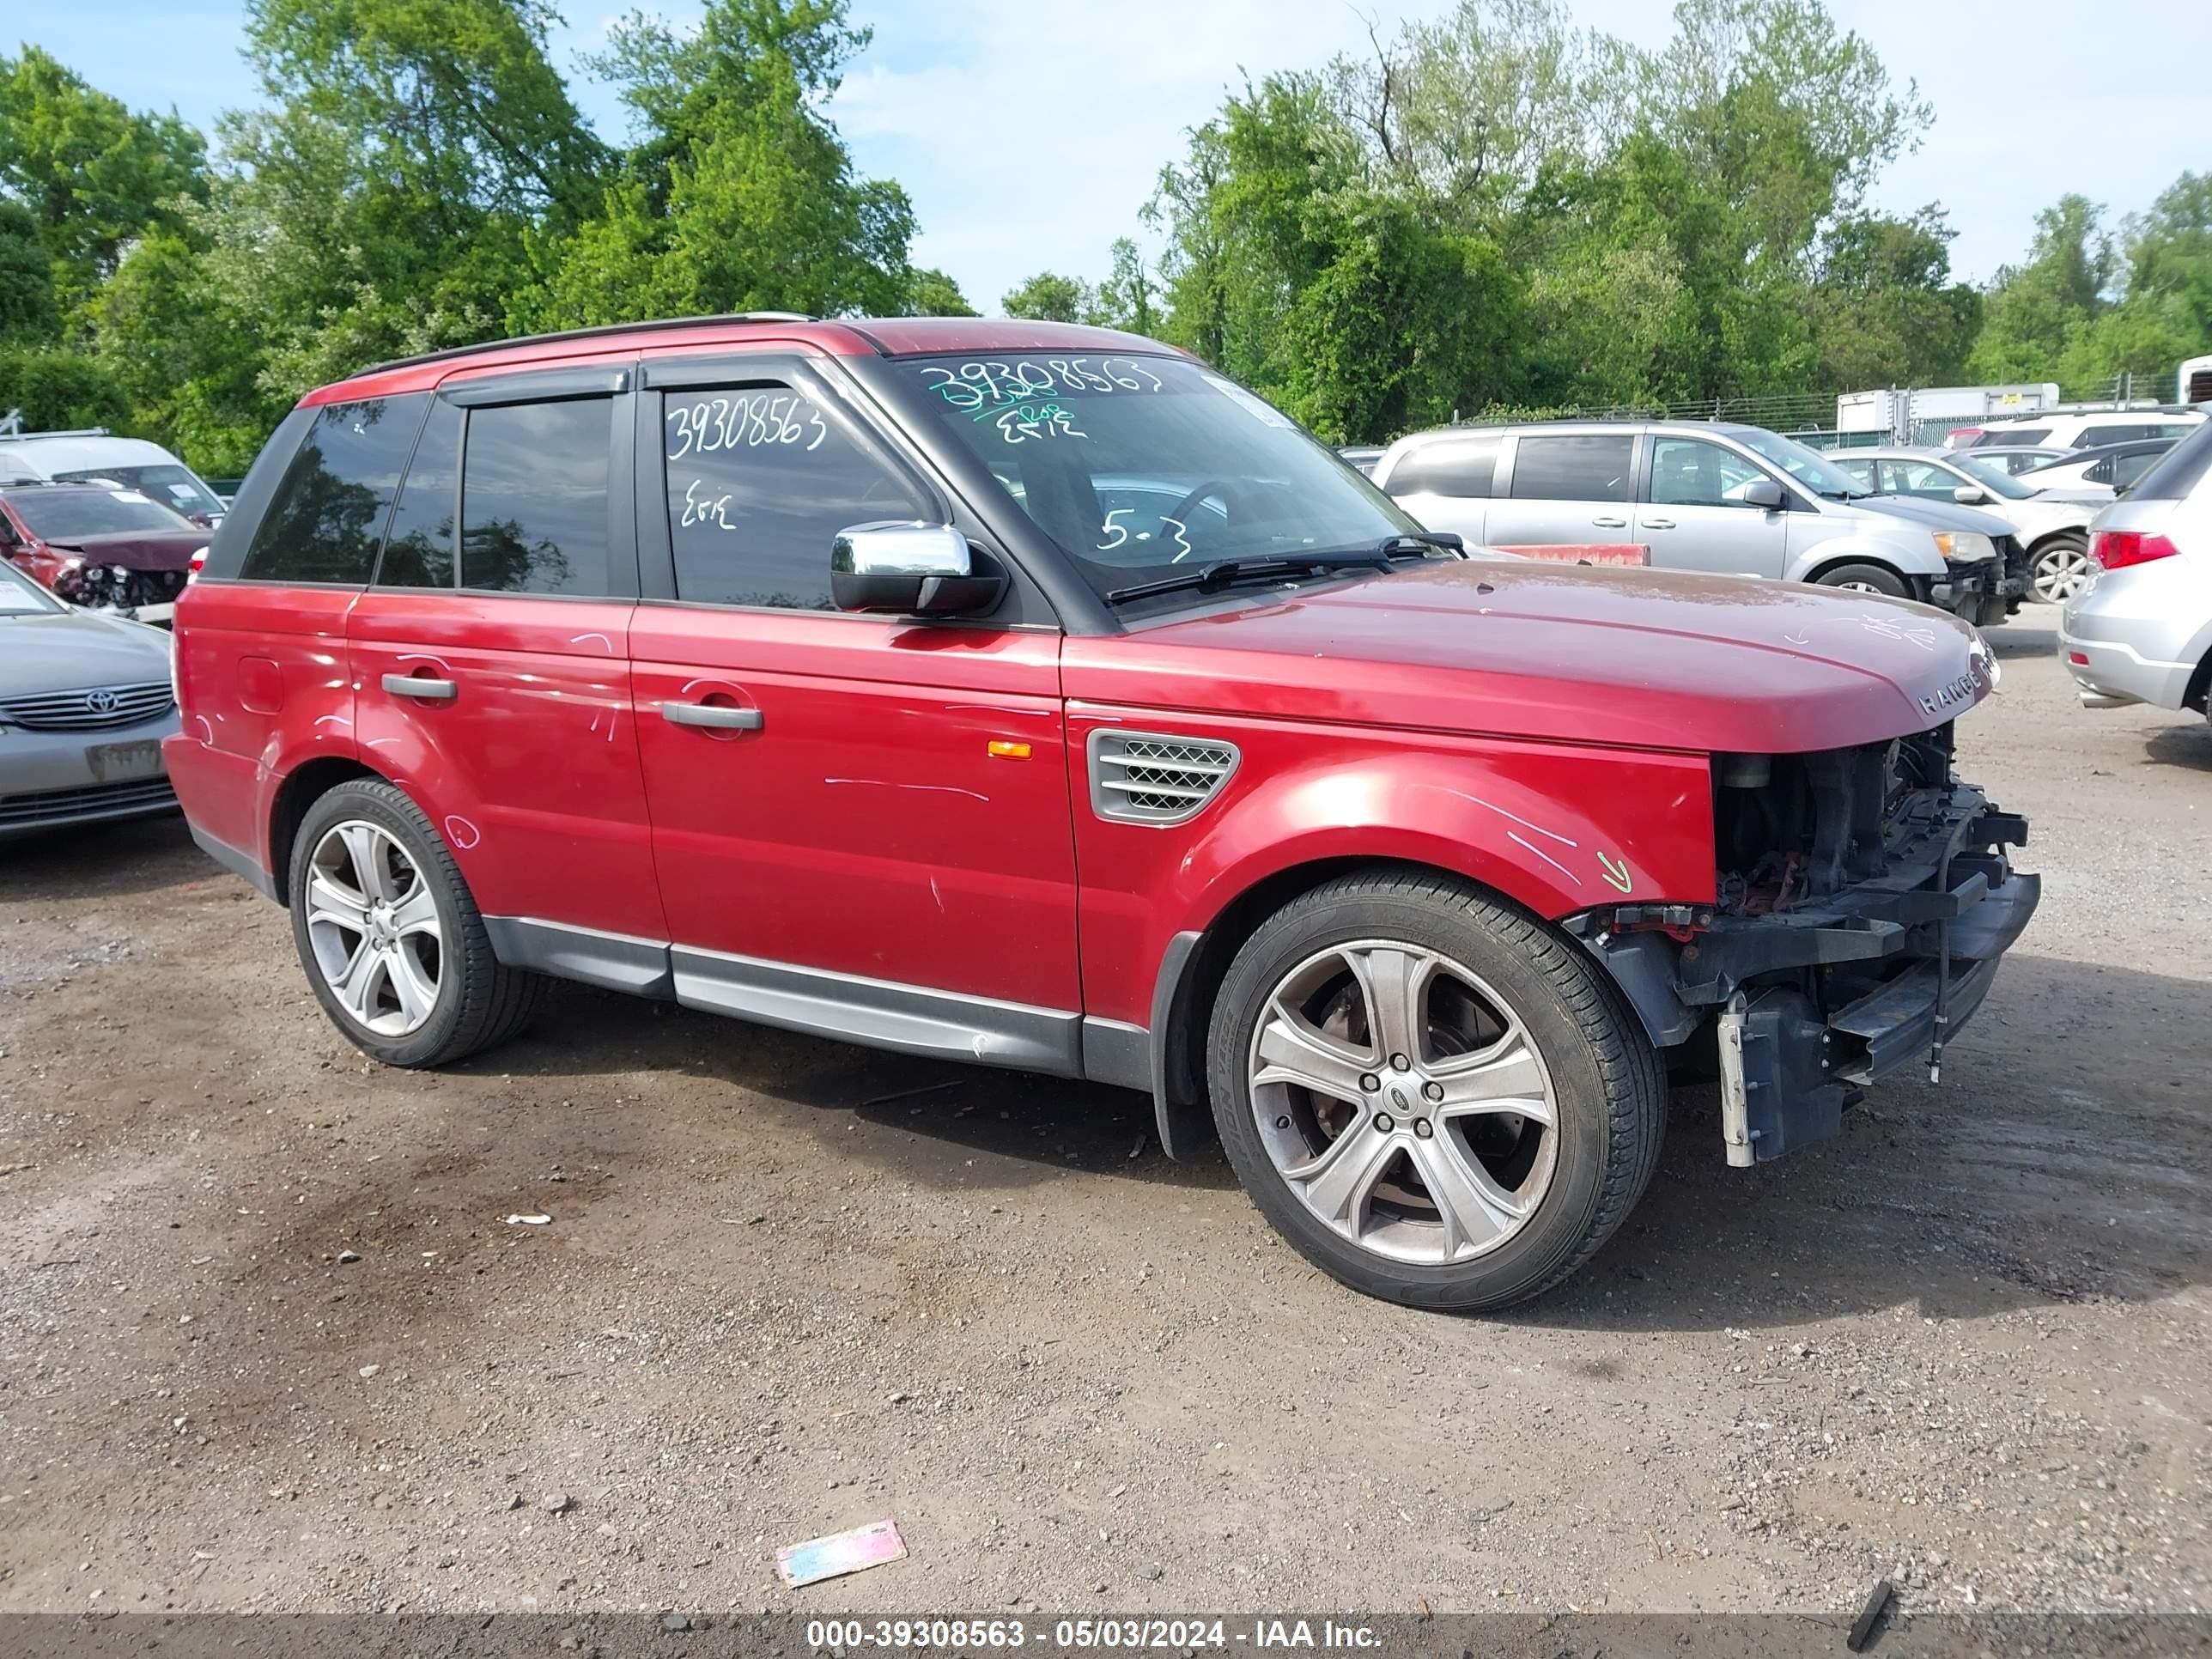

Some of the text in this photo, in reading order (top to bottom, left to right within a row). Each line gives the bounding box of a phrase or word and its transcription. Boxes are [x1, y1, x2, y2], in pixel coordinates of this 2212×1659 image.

[921, 358, 1161, 405] 39308563
[667, 394, 827, 461] 39308563
[1917, 671, 1982, 715] RANGE
